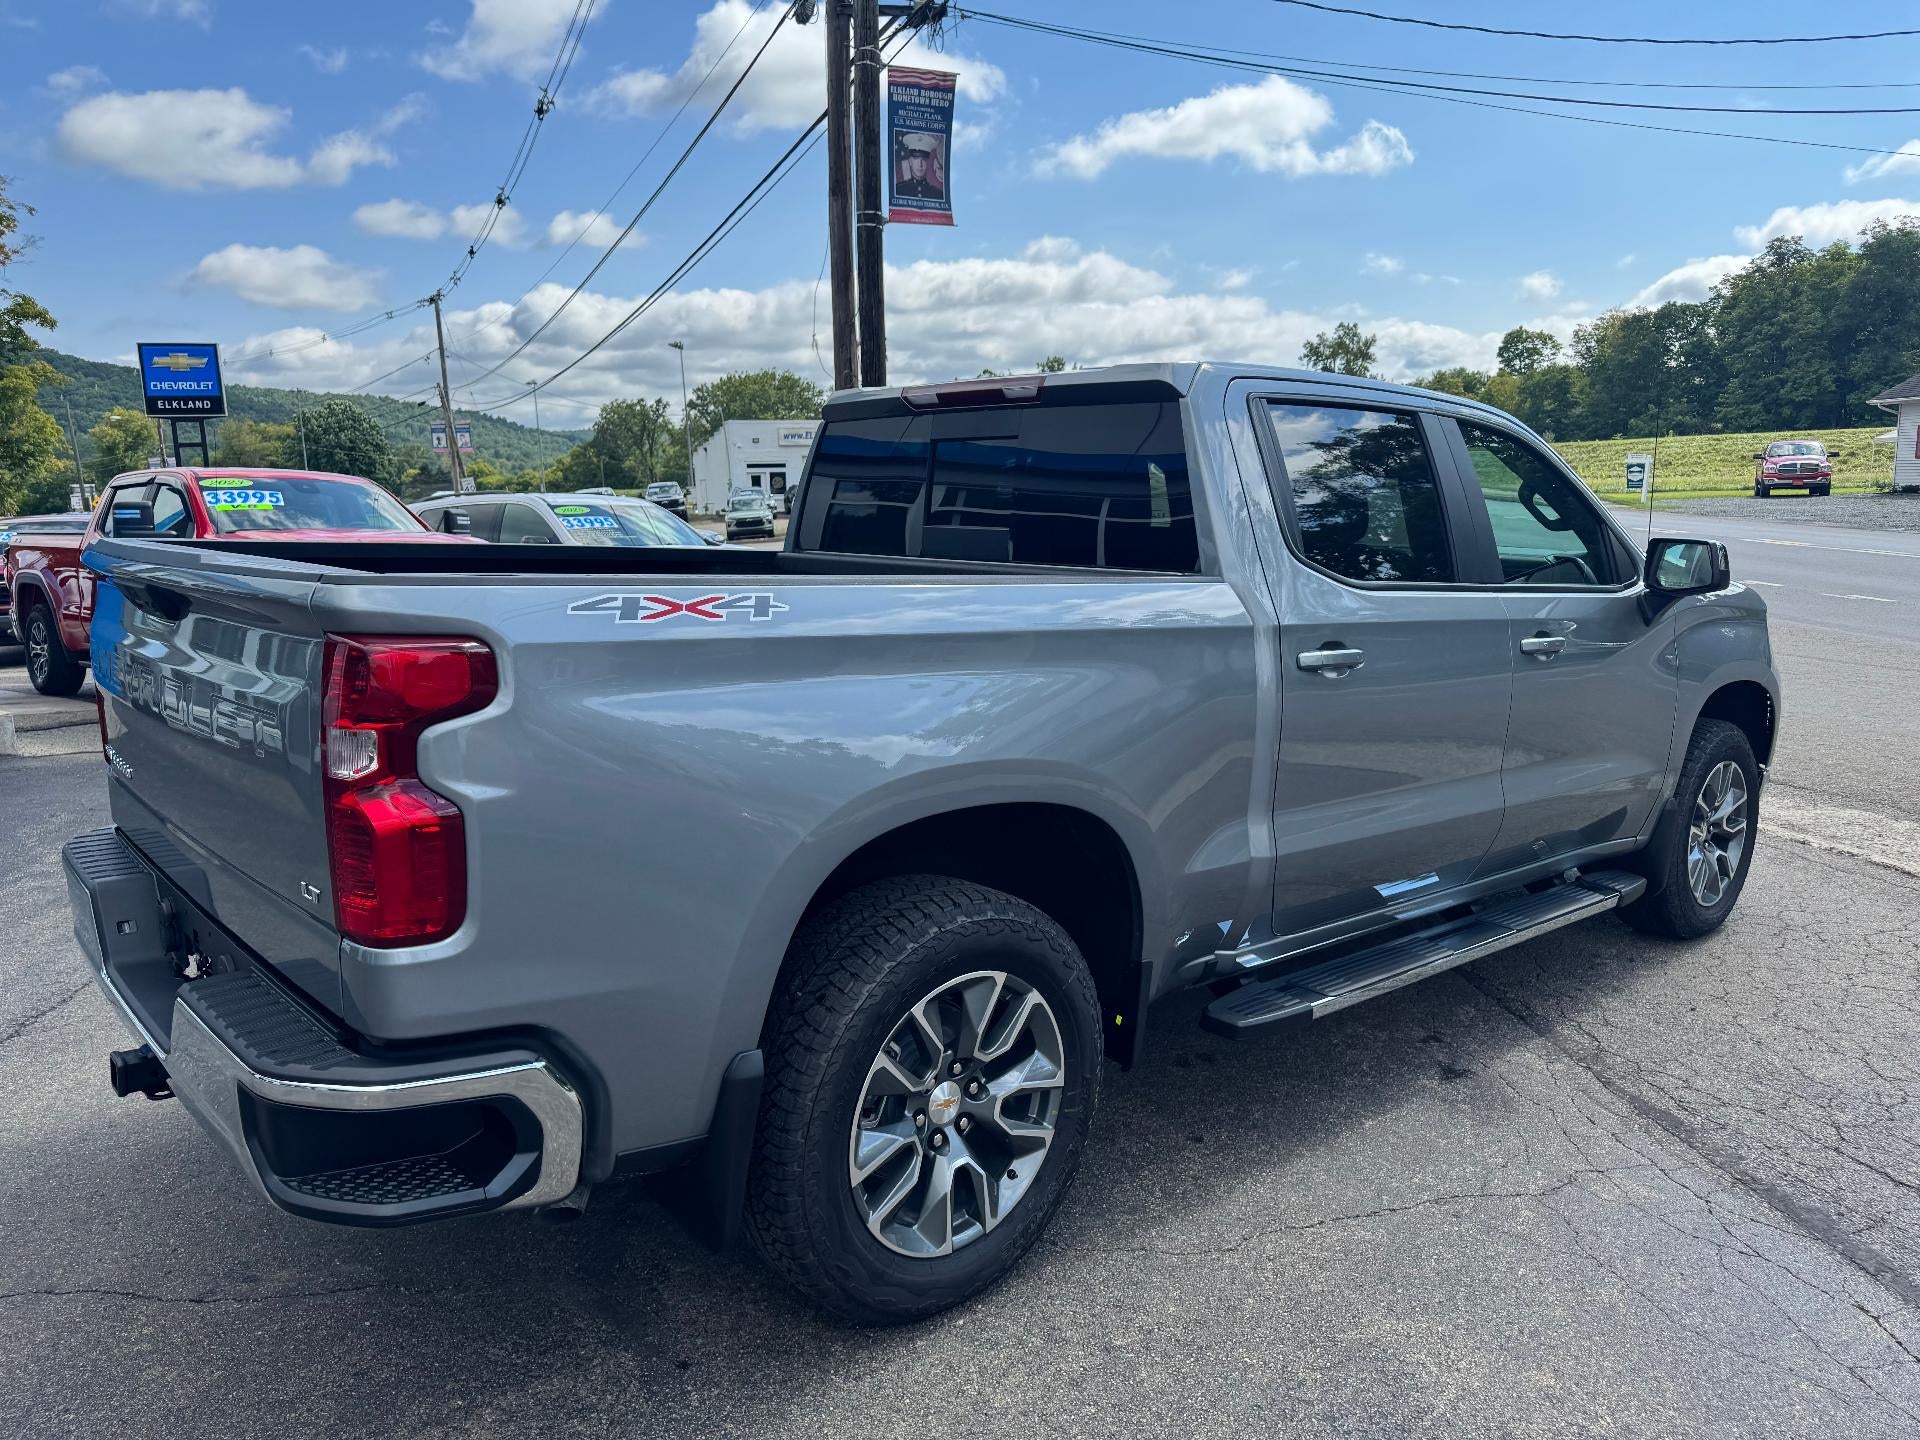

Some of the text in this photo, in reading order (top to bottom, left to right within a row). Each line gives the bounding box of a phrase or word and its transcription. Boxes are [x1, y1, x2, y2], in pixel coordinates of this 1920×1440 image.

[890, 85, 953, 100] ELKLAND BOROUGH
[892, 93, 949, 108] HOMETOWN HERO
[898, 109, 923, 118] MICHAEL
[905, 119, 927, 128] MARINE
[927, 122, 946, 130] CORPS
[150, 381, 213, 390] CHEVROLET
[157, 400, 211, 409] ELKLAND
[206, 491, 282, 505] 33995
[561, 517, 615, 529] 33995
[300, 881, 320, 904] LT
